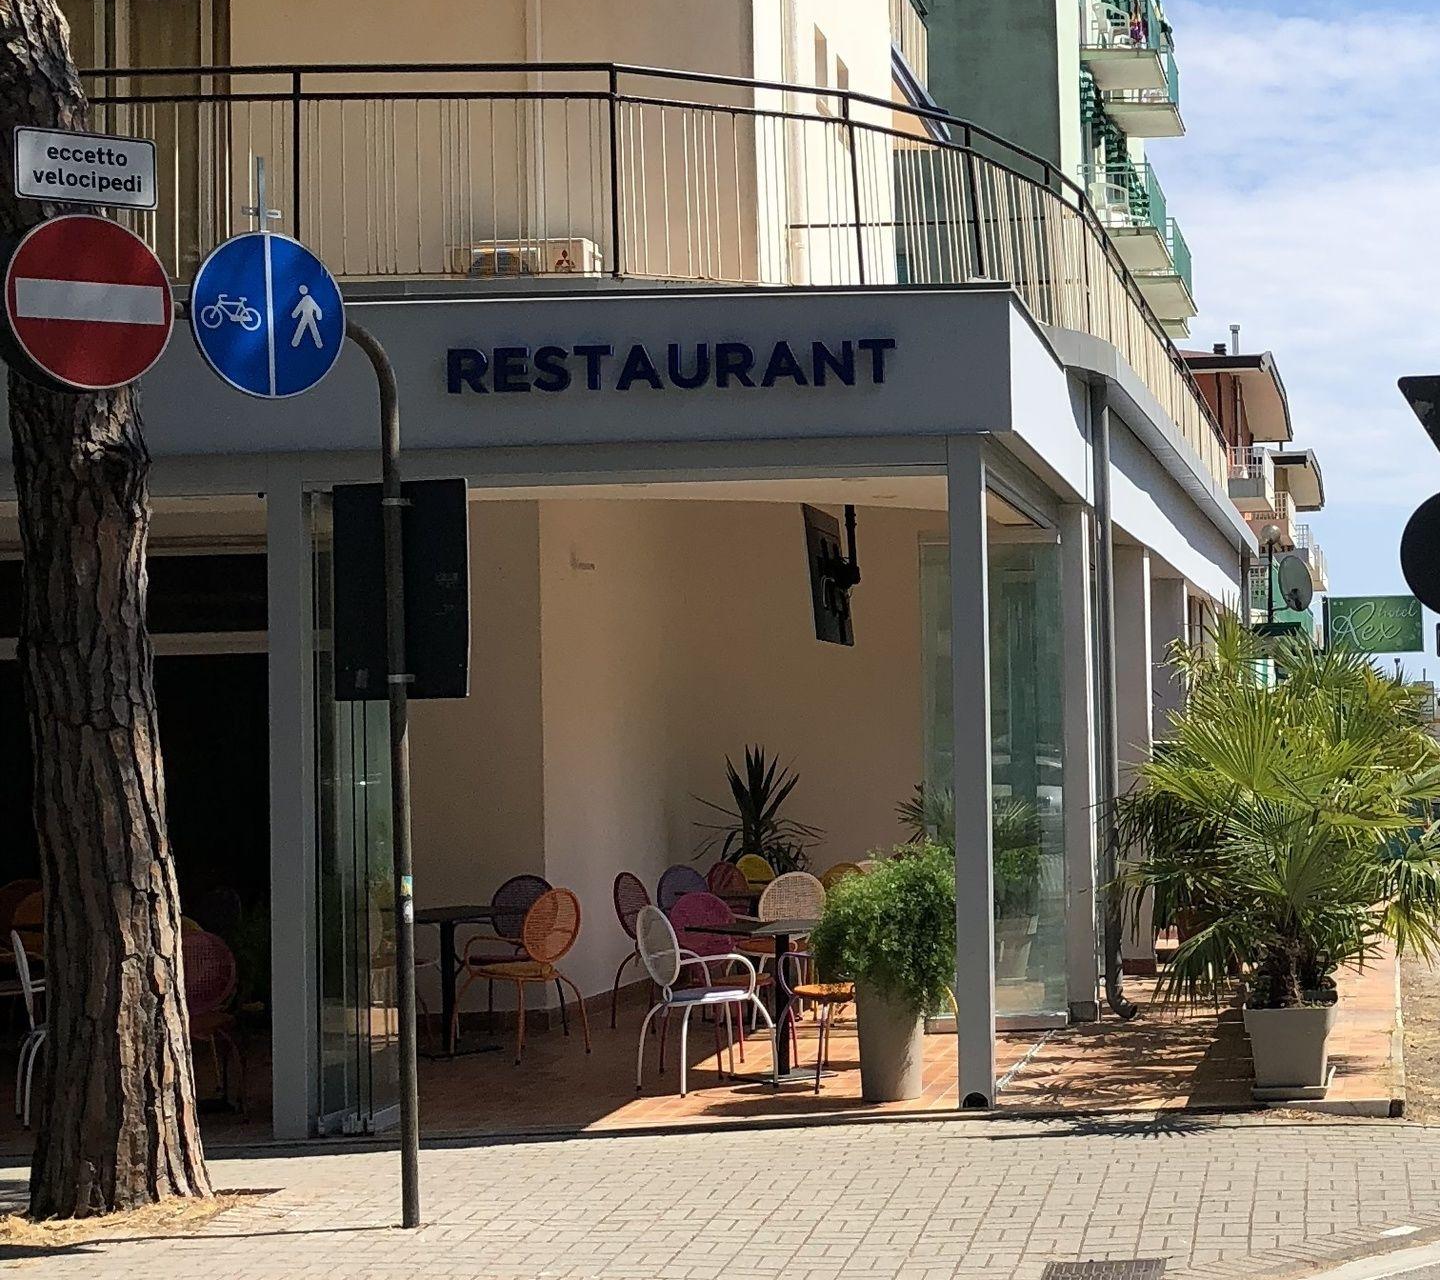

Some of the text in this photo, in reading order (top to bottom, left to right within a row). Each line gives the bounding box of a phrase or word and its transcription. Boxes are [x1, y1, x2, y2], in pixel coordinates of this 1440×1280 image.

[46, 145, 128, 168] eccetto
[32, 168, 143, 193] velocipedi
[446, 338, 896, 394] RESTAURANT
[1377, 599, 1418, 618] hotel
[1331, 601, 1402, 651] Rex
